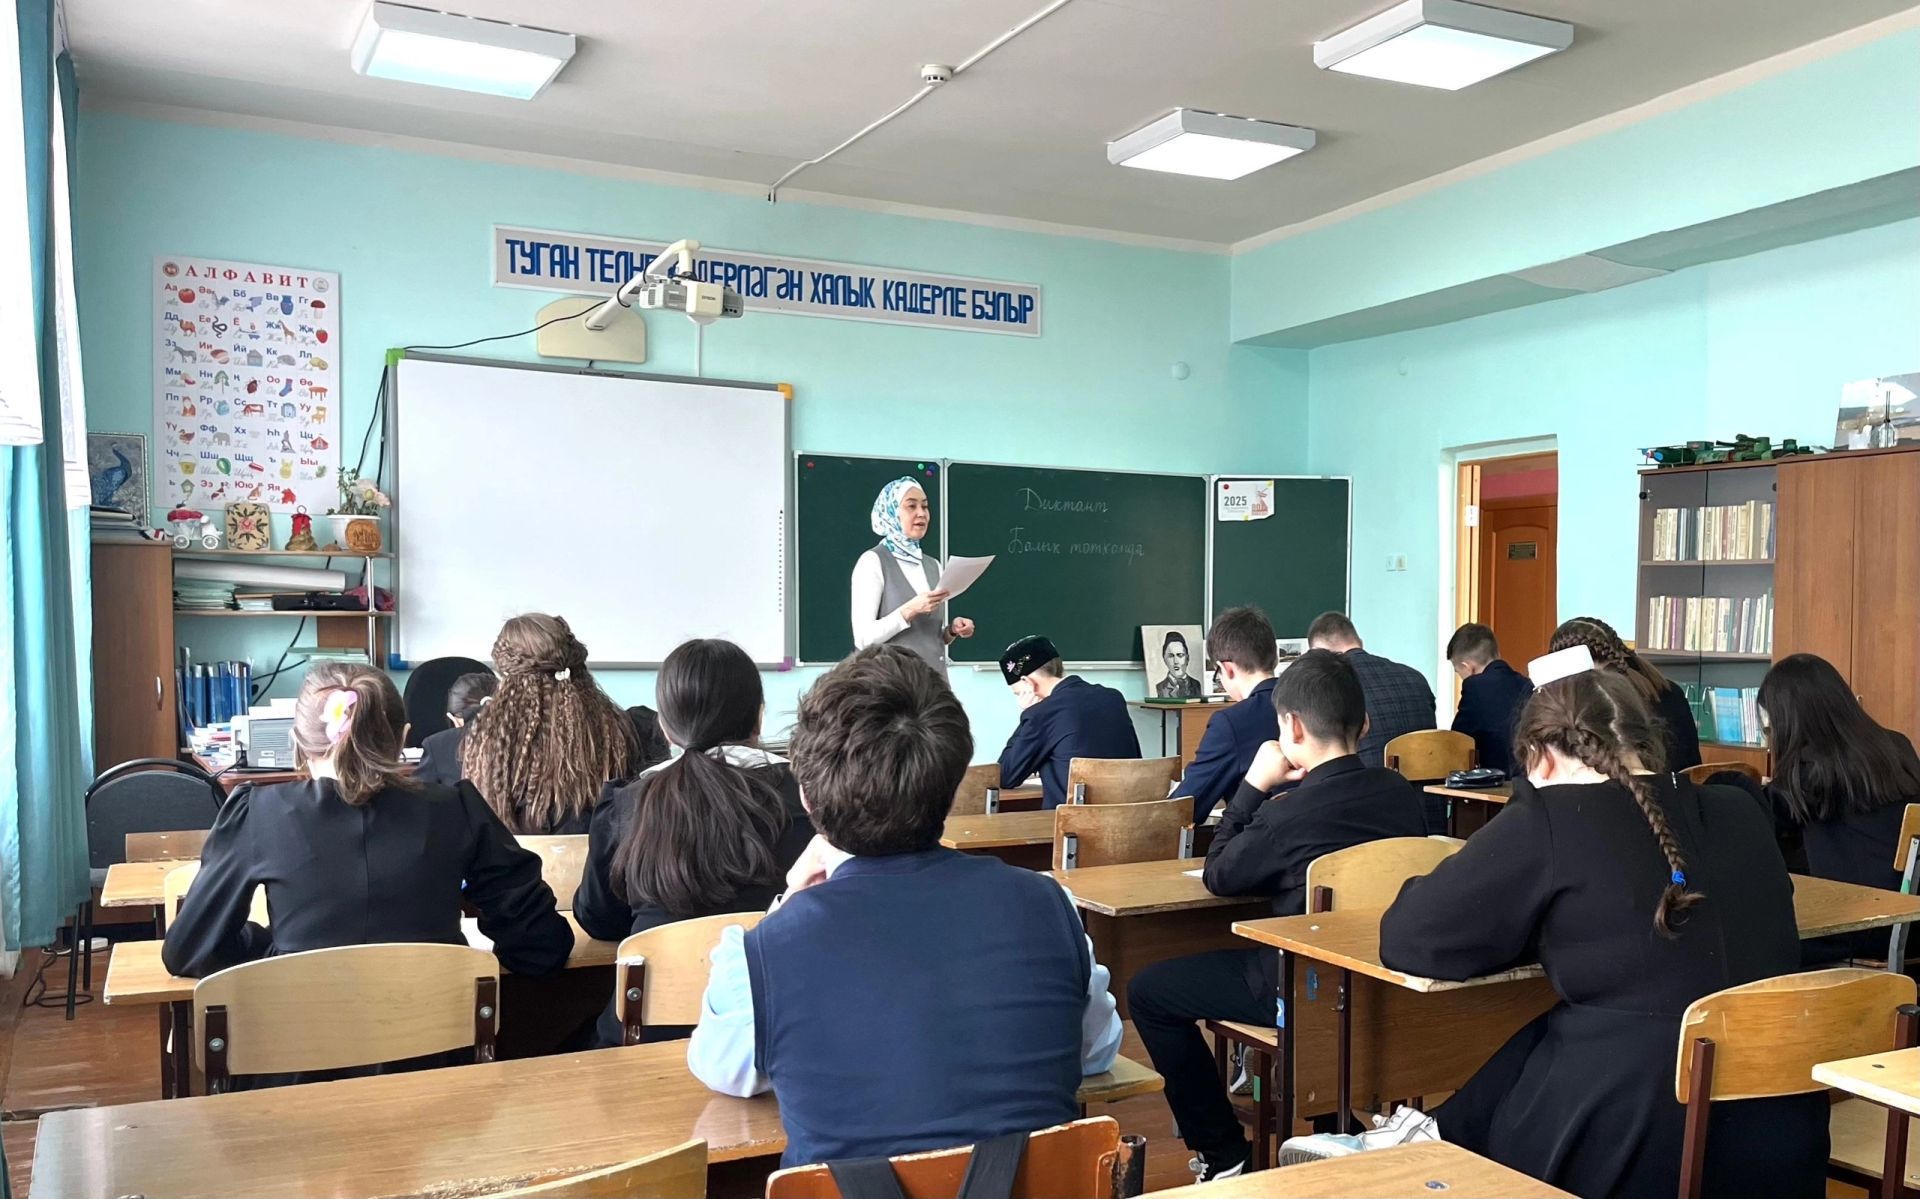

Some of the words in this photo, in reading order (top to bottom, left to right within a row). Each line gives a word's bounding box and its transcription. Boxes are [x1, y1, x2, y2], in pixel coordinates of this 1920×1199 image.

[185, 264, 309, 288] АЛФАВИТ
[505, 239, 579, 280] ТУГАН
[810, 271, 876, 309] ХАЛЫК
[882, 279, 966, 318] КАДЕРЛЕ
[971, 289, 1034, 324] БУЛЫР
[164, 282, 178, 292] Аа
[233, 289, 247, 298] Бб
[265, 292, 279, 301] Вв
[299, 296, 309, 304] Гг
[164, 311, 179, 321] Дд
[199, 314, 211, 323] Ее
[266, 320, 281, 329] Жж
[199, 341, 213, 349] Ии
[233, 343, 247, 352] Йй
[266, 347, 278, 356] Кк
[299, 350, 312, 359] Лл
[165, 367, 182, 376] Мм
[199, 369, 213, 378] Нн
[266, 375, 280, 384] Оо
[165, 392, 179, 401] Пп
[199, 395, 213, 405] Рр
[233, 398, 247, 406] Сс
[266, 400, 278, 408] Тт
[199, 424, 218, 433] Фф
[234, 426, 247, 434] Хх
[300, 431, 313, 440] Цц
[166, 449, 179, 457] Чч
[200, 451, 219, 460] Шш
[234, 453, 254, 463] Щщ
[300, 457, 318, 466] Ыы
[200, 480, 213, 488] Ээ
[234, 481, 254, 489] Юю
[267, 483, 280, 491] Яя
[1016, 488, 1109, 513] Диктант
[1224, 495, 1247, 507] 2025
